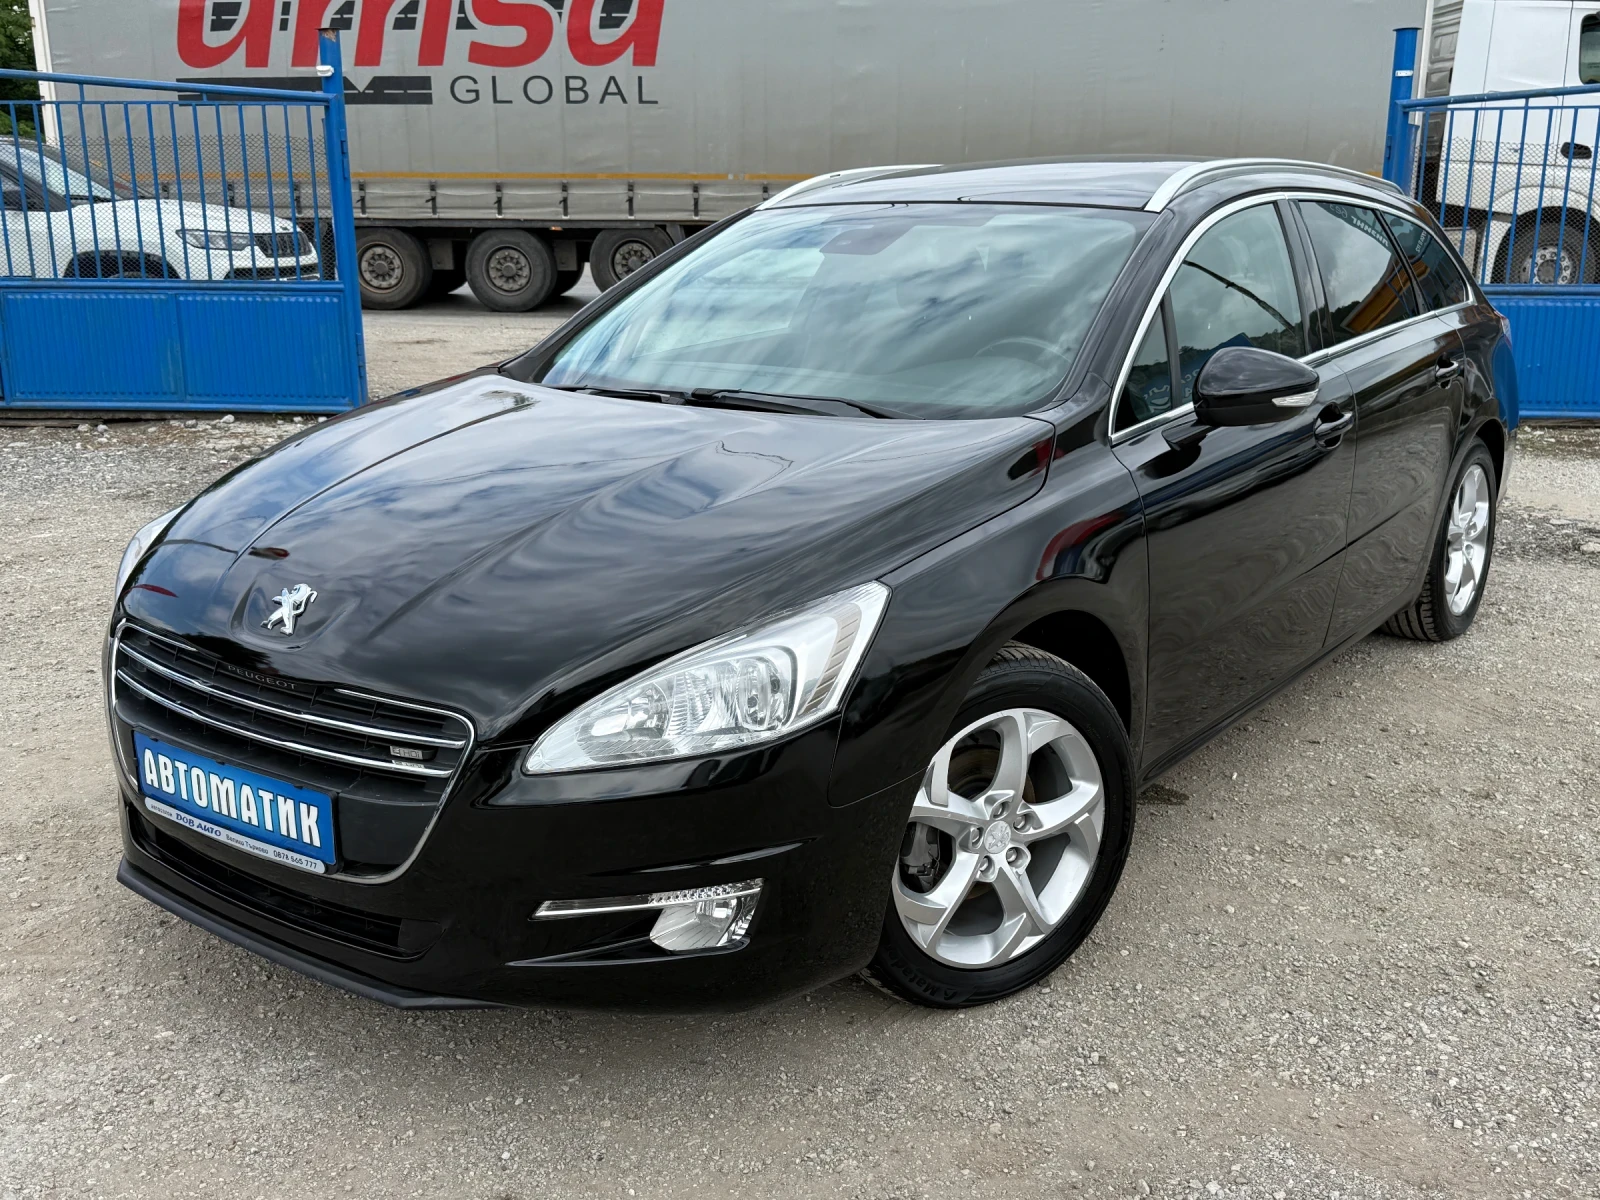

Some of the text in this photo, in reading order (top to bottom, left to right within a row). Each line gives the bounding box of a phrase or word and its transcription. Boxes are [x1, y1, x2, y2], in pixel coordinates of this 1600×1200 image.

[449, 75, 659, 105] GLOBAL
[228, 665, 297, 690] PEUGEOT
[144, 747, 322, 849] АВТОМАТИК
